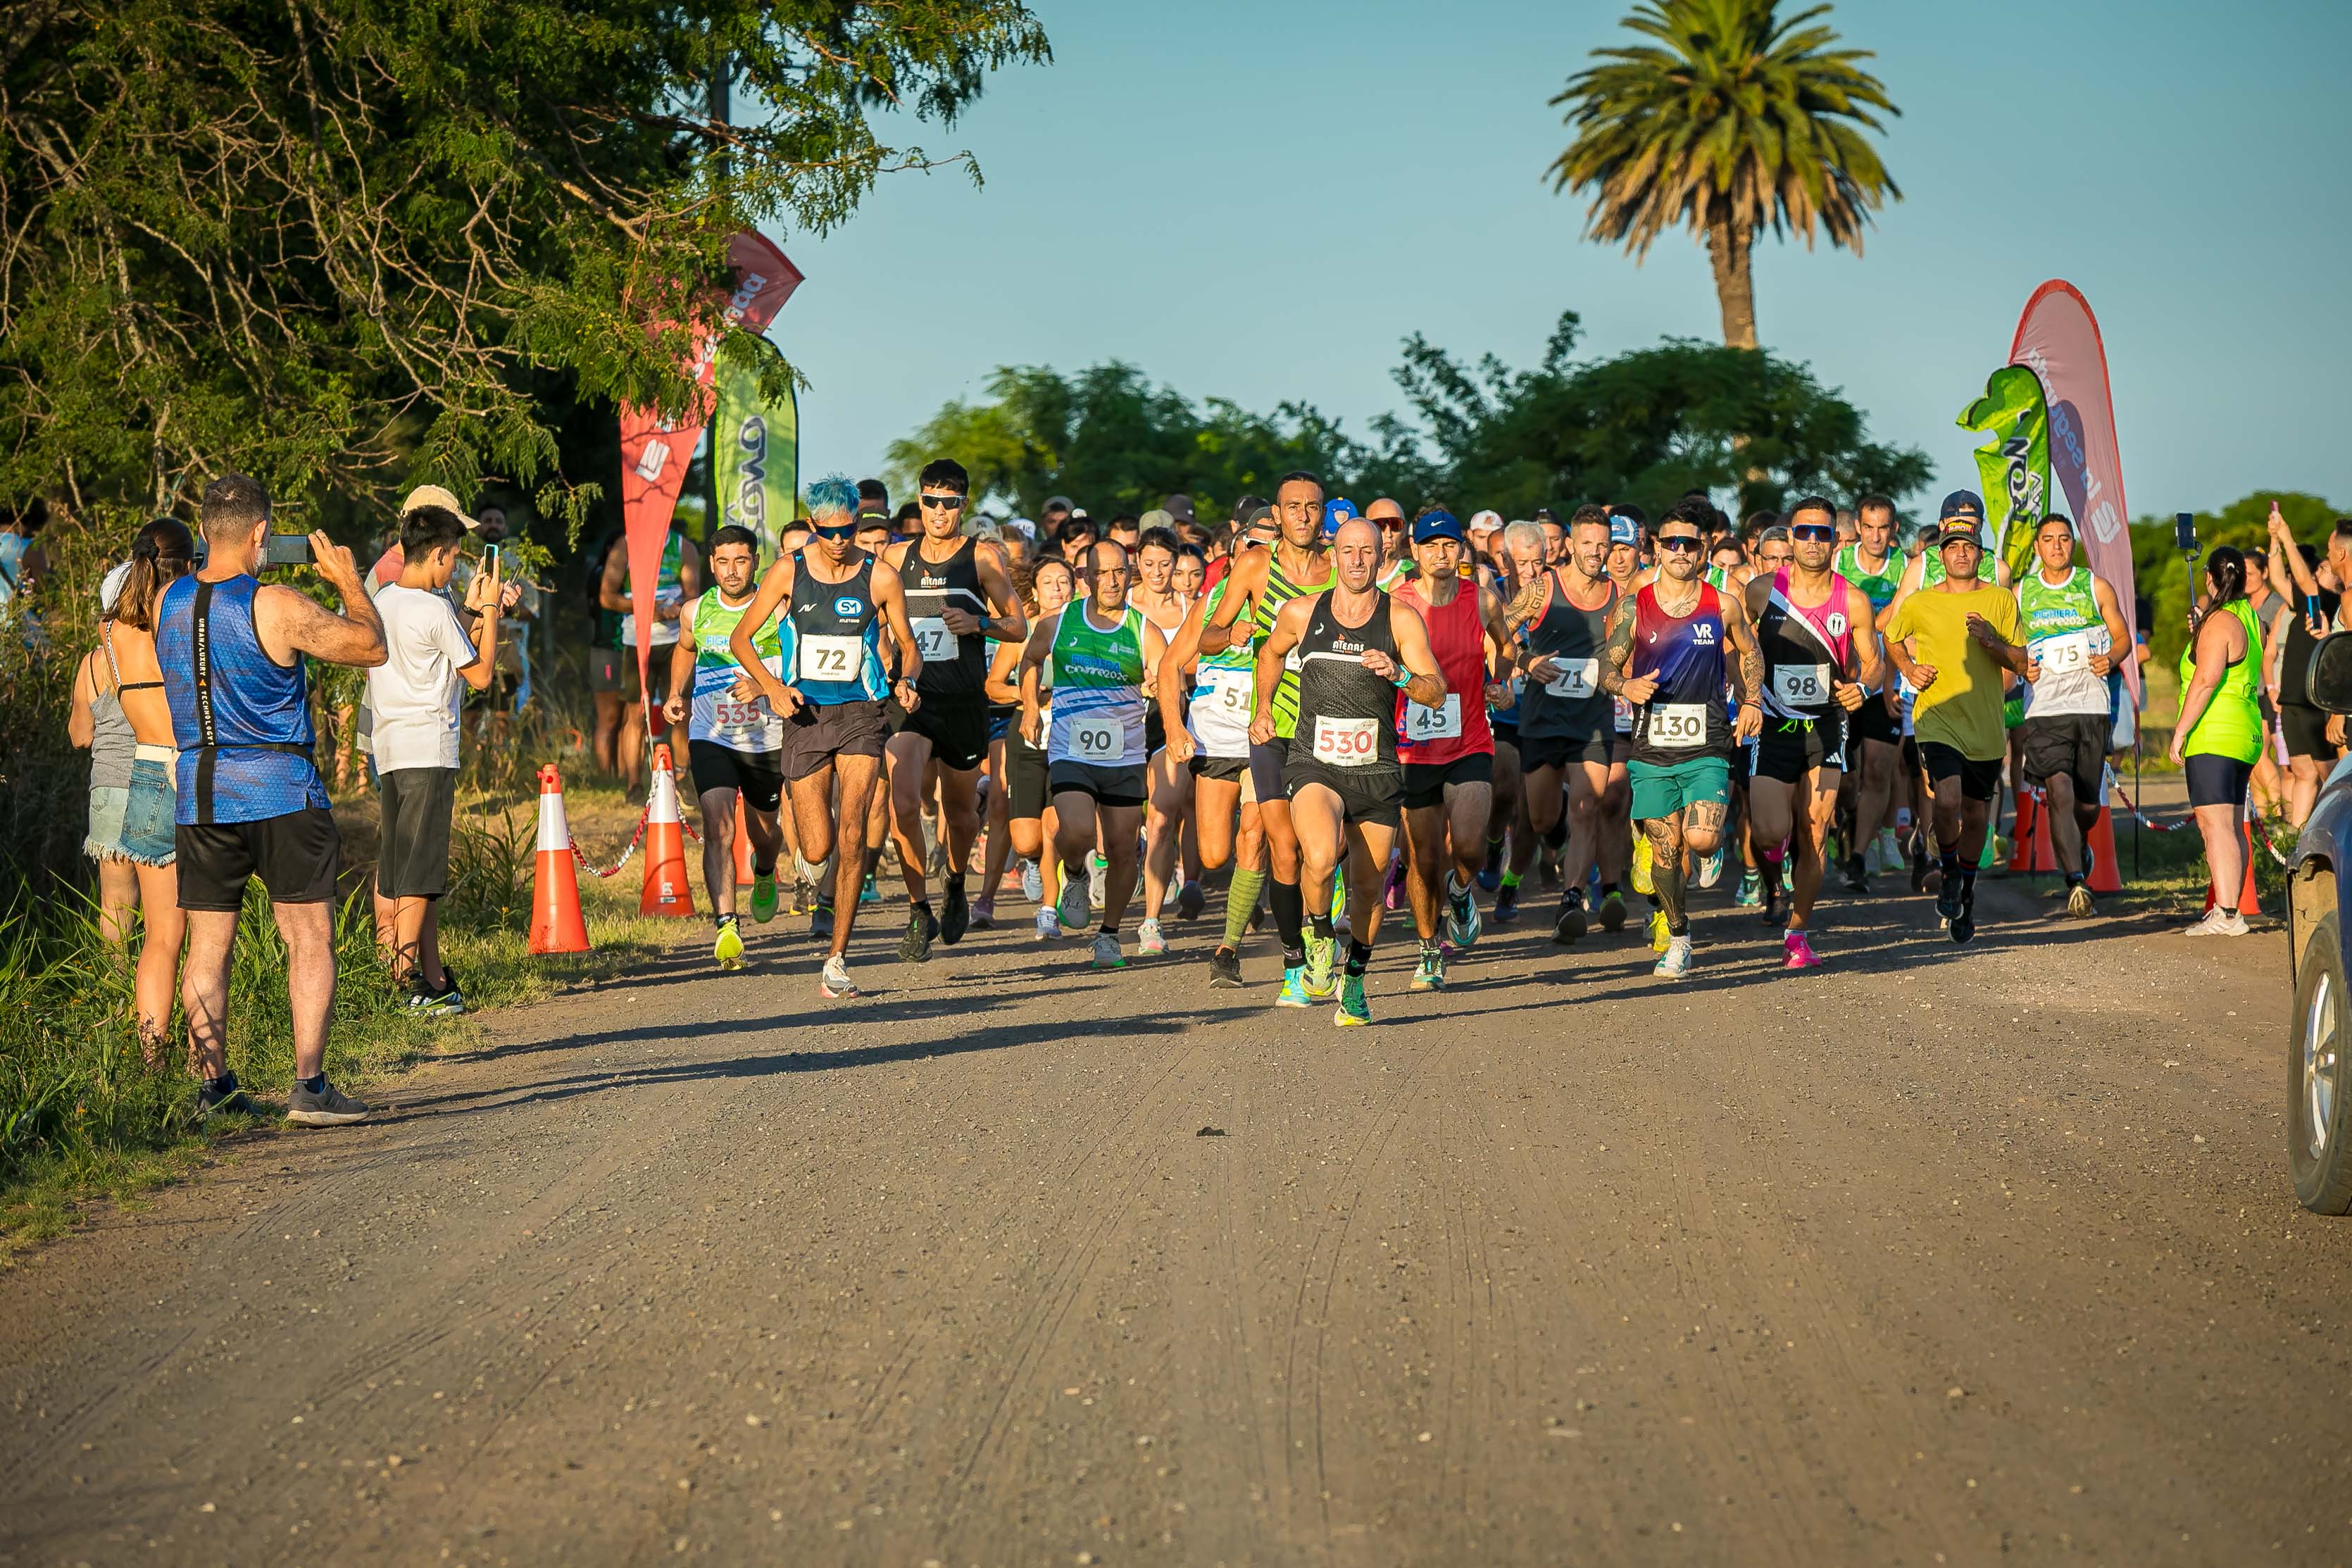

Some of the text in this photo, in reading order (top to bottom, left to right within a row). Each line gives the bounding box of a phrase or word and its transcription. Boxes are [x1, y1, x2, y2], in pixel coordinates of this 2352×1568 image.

[920, 577, 947, 586] ATENAS
[915, 631, 944, 651] 47
[1693, 624, 1713, 638] VR
[1332, 640, 1365, 652] ATENAS
[2054, 645, 2079, 665] 75
[816, 649, 846, 670] 72
[1558, 670, 1584, 688] 71
[1787, 677, 1817, 696] 98
[717, 701, 761, 724] 535
[1416, 707, 1446, 729] 45
[1654, 716, 1701, 736] 130
[1080, 730, 1111, 751] 90
[1319, 729, 1372, 753] 530
